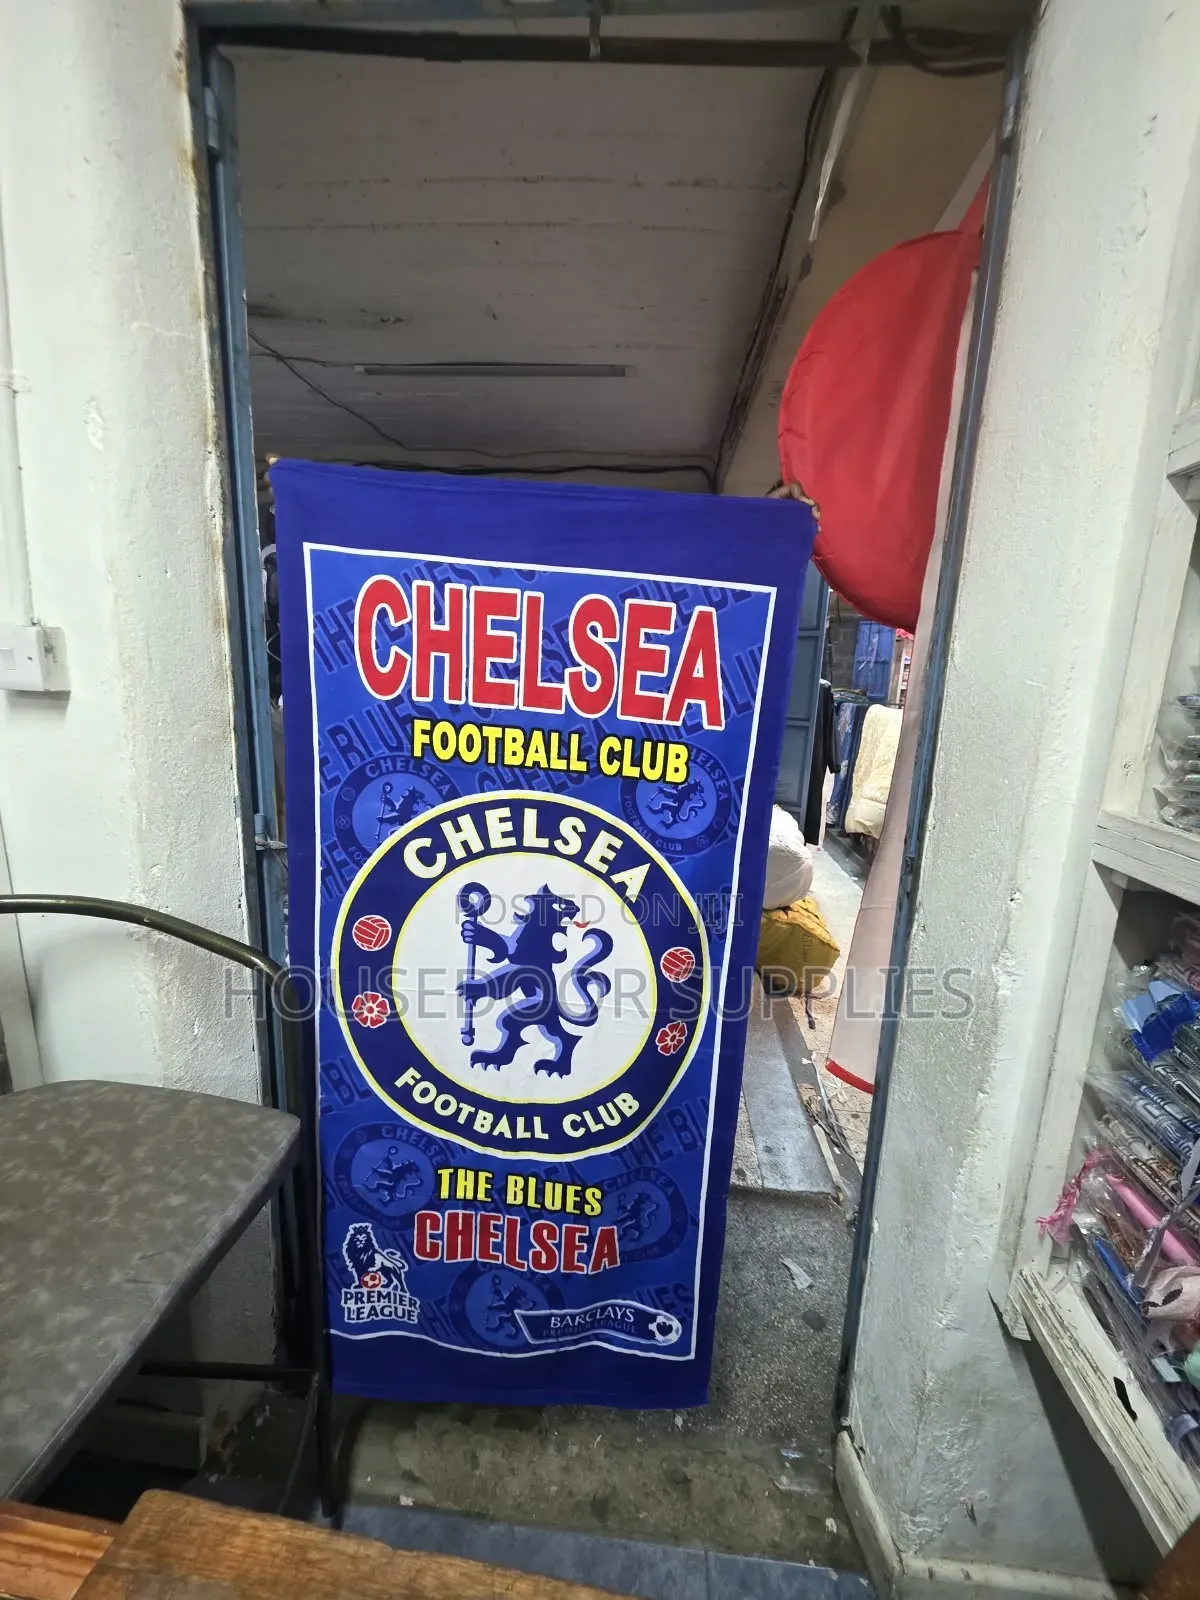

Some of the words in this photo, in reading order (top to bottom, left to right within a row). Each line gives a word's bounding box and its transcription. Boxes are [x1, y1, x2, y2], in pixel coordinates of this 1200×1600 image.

[354, 574, 725, 731] CHELSEA
[412, 718, 589, 773] FOOTBALL
[600, 737, 690, 783] CLUB
[366, 758, 451, 796] CHELSEA
[403, 807, 651, 903] CHELSEA
[655, 839, 683, 851] CLUB
[394, 1066, 549, 1140] FOOTBALL
[562, 1092, 640, 1139] CLUB
[437, 1167, 493, 1202] THE
[506, 1177, 603, 1217] BLUES
[414, 1209, 621, 1275] CHELSEA
[342, 1288, 419, 1309] PREMIER
[345, 1304, 418, 1323] LEAGUE
[550, 1306, 635, 1329] BARCLAYS
